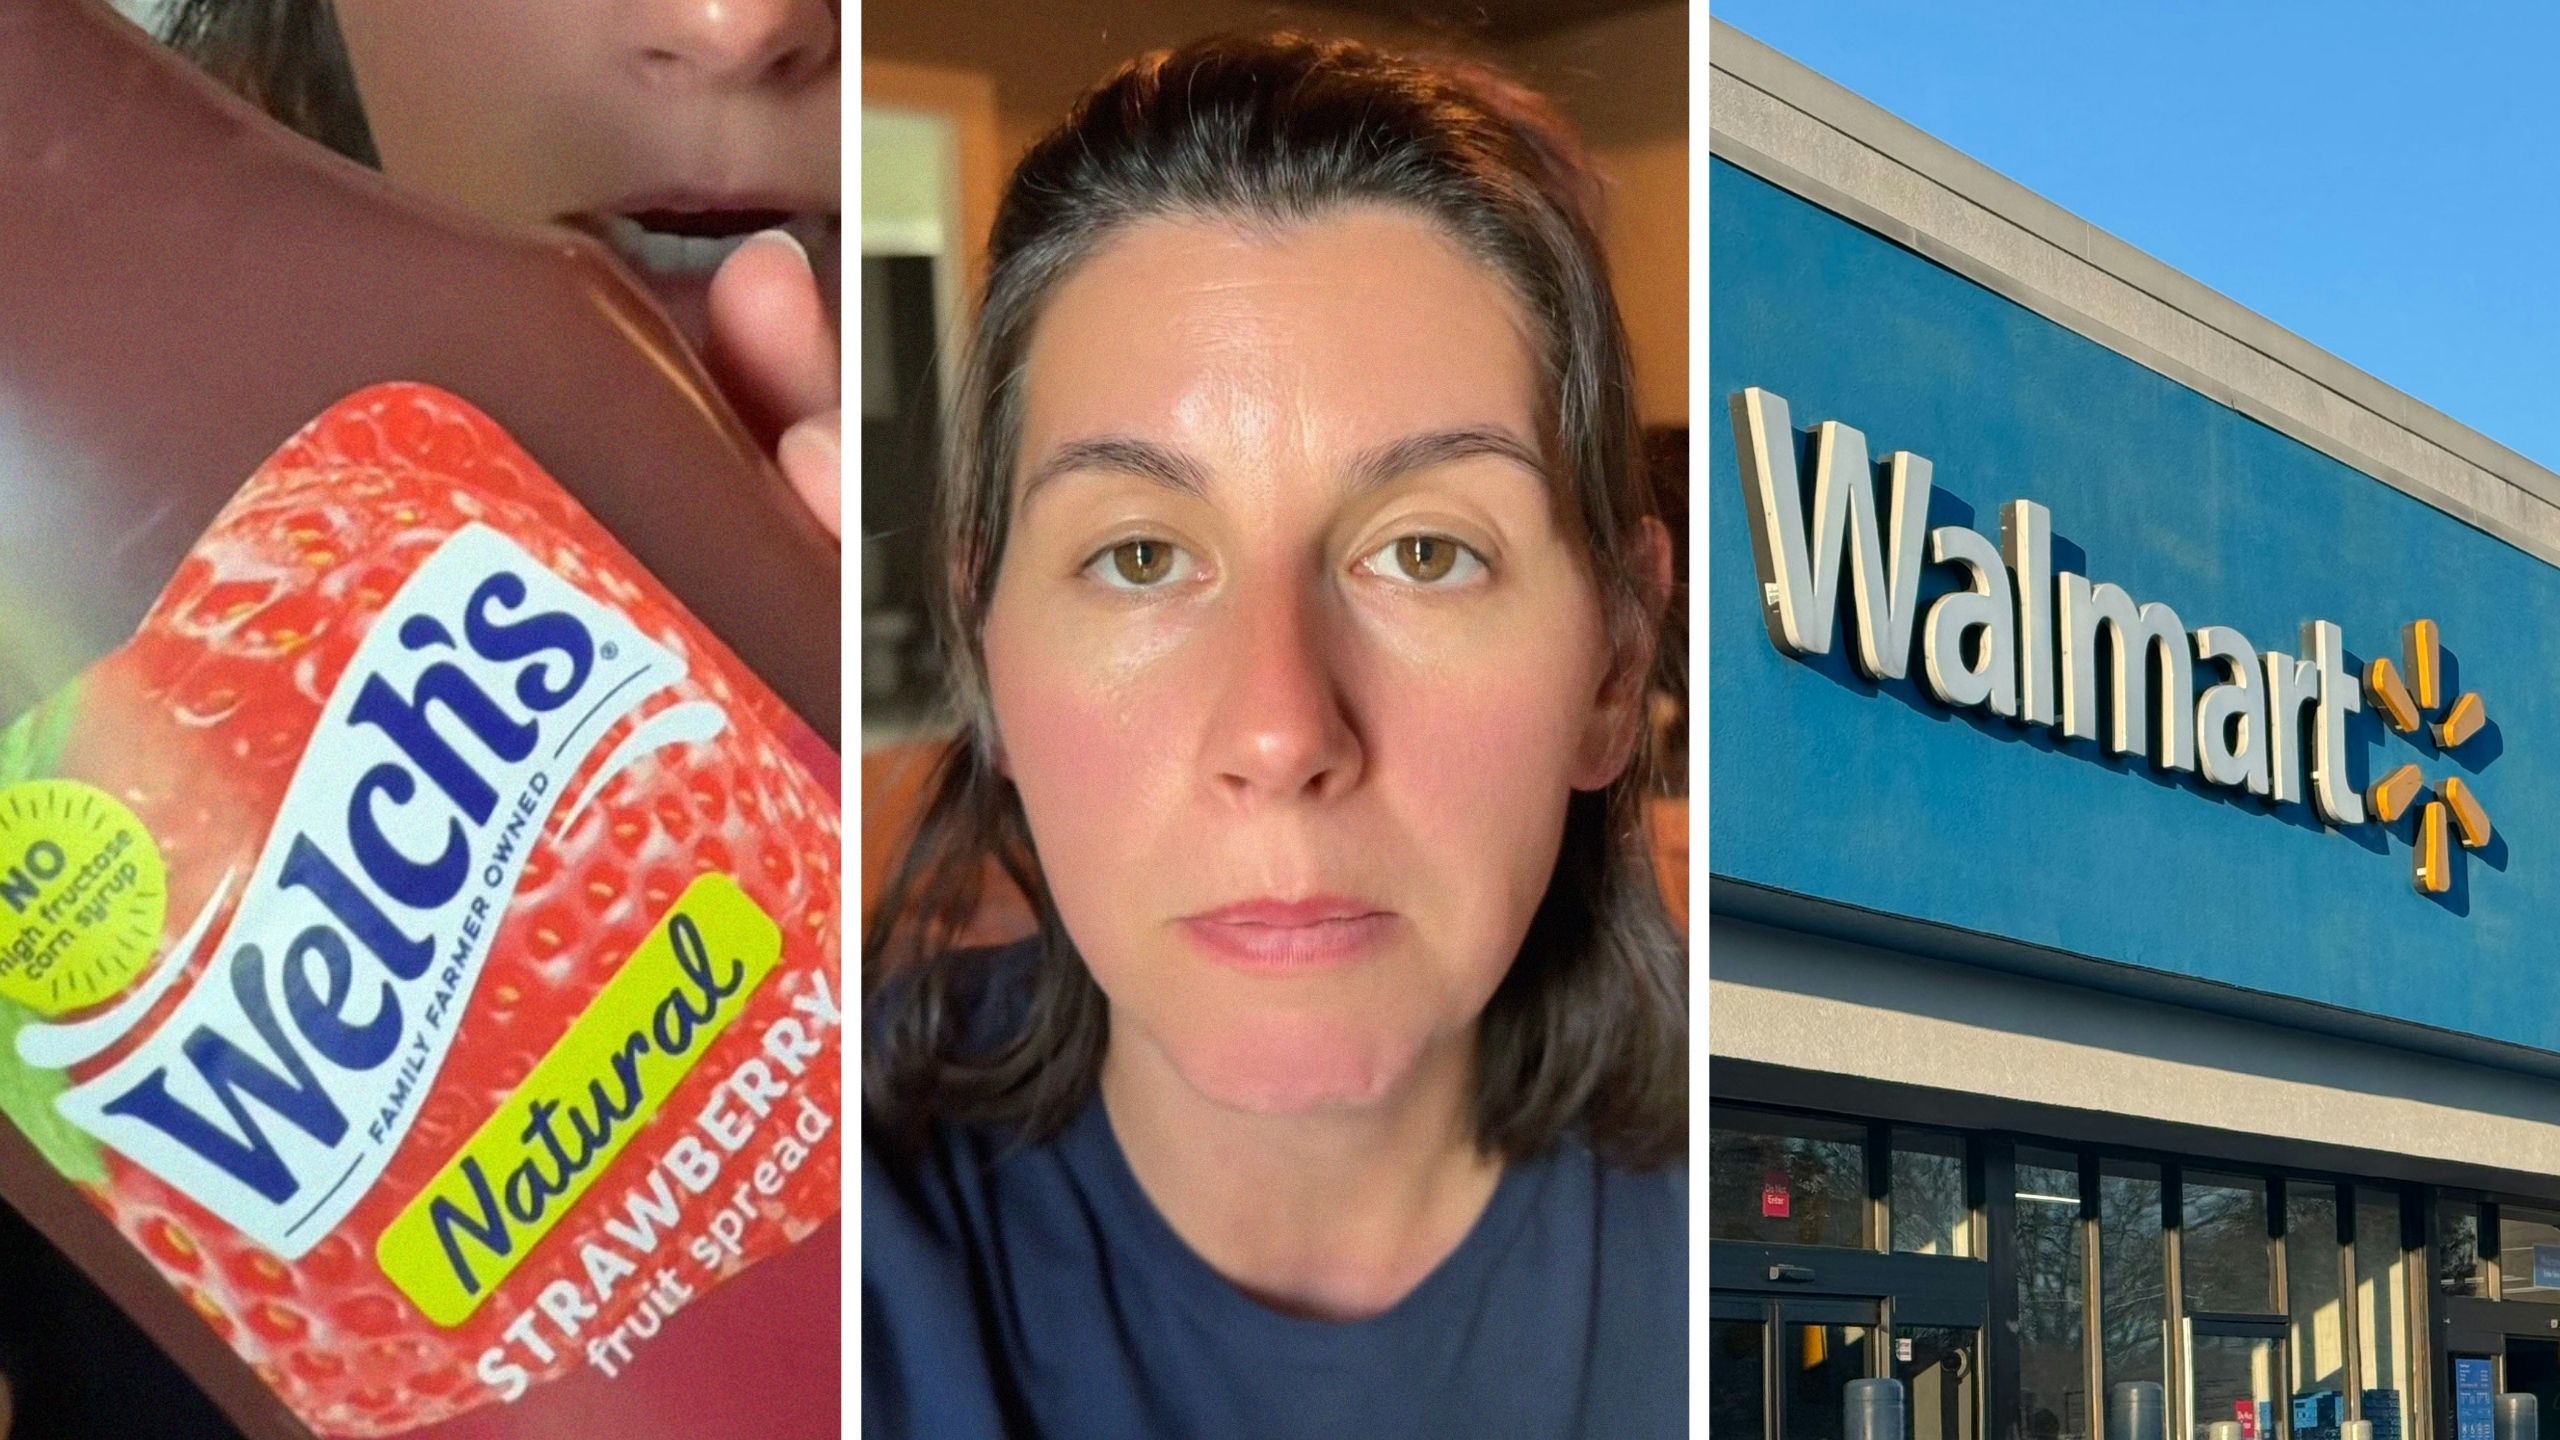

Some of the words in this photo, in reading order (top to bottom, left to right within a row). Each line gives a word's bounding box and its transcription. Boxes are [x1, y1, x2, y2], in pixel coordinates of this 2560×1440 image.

[1731, 387, 2365, 826] Walmart
[0, 839, 66, 915] NO
[24, 928, 76, 981] corn
[73, 861, 138, 929] syrup
[39, 828, 133, 925] fructose
[101, 571, 595, 1206] Welch's
[367, 1032, 432, 1145] FAMILY
[425, 896, 491, 1030] FARMER
[484, 771, 549, 888] OWNED
[428, 912, 745, 1296] Natural
[475, 968, 841, 1403] STRAWBERRY
[586, 1267, 695, 1379] fruit
[689, 1096, 833, 1271] spread
